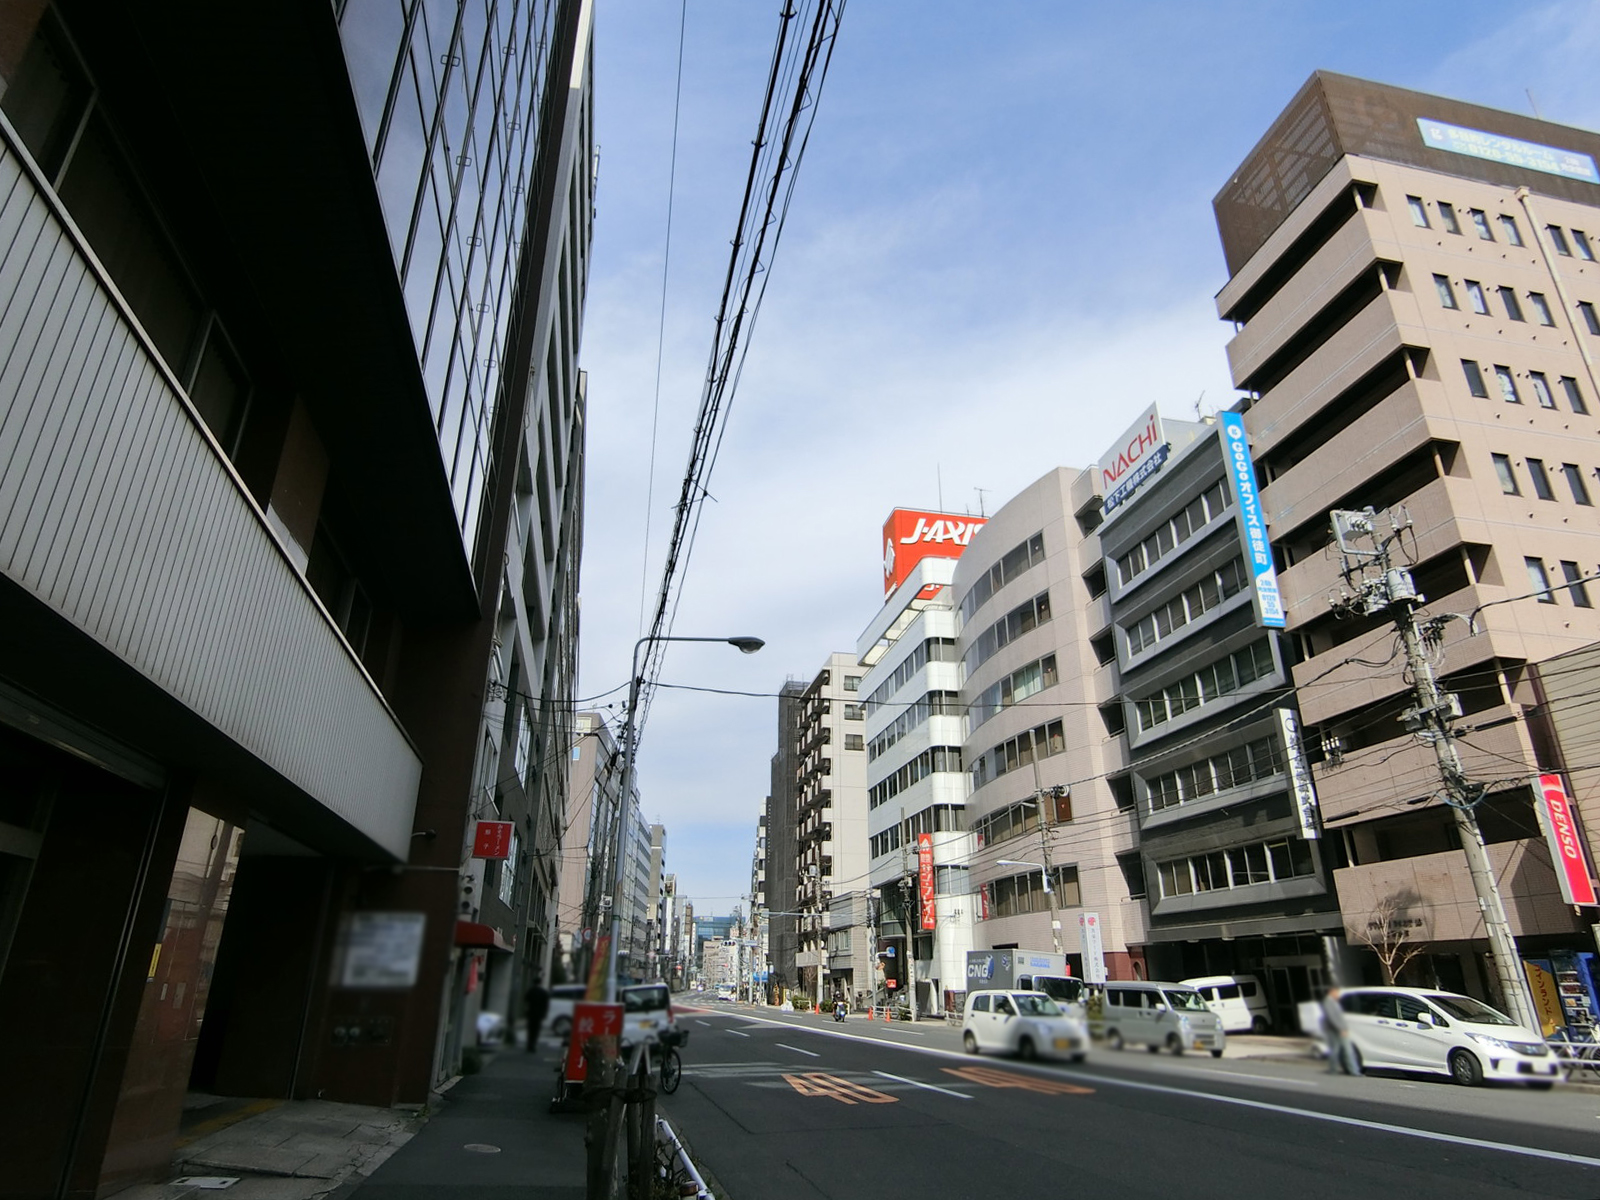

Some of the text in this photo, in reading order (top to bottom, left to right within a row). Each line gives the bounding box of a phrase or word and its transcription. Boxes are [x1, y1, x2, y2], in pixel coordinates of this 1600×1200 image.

[1550, 799, 1578, 860] DENSO
[967, 964, 988, 978] CNG
[781, 1073, 900, 1105] 40
